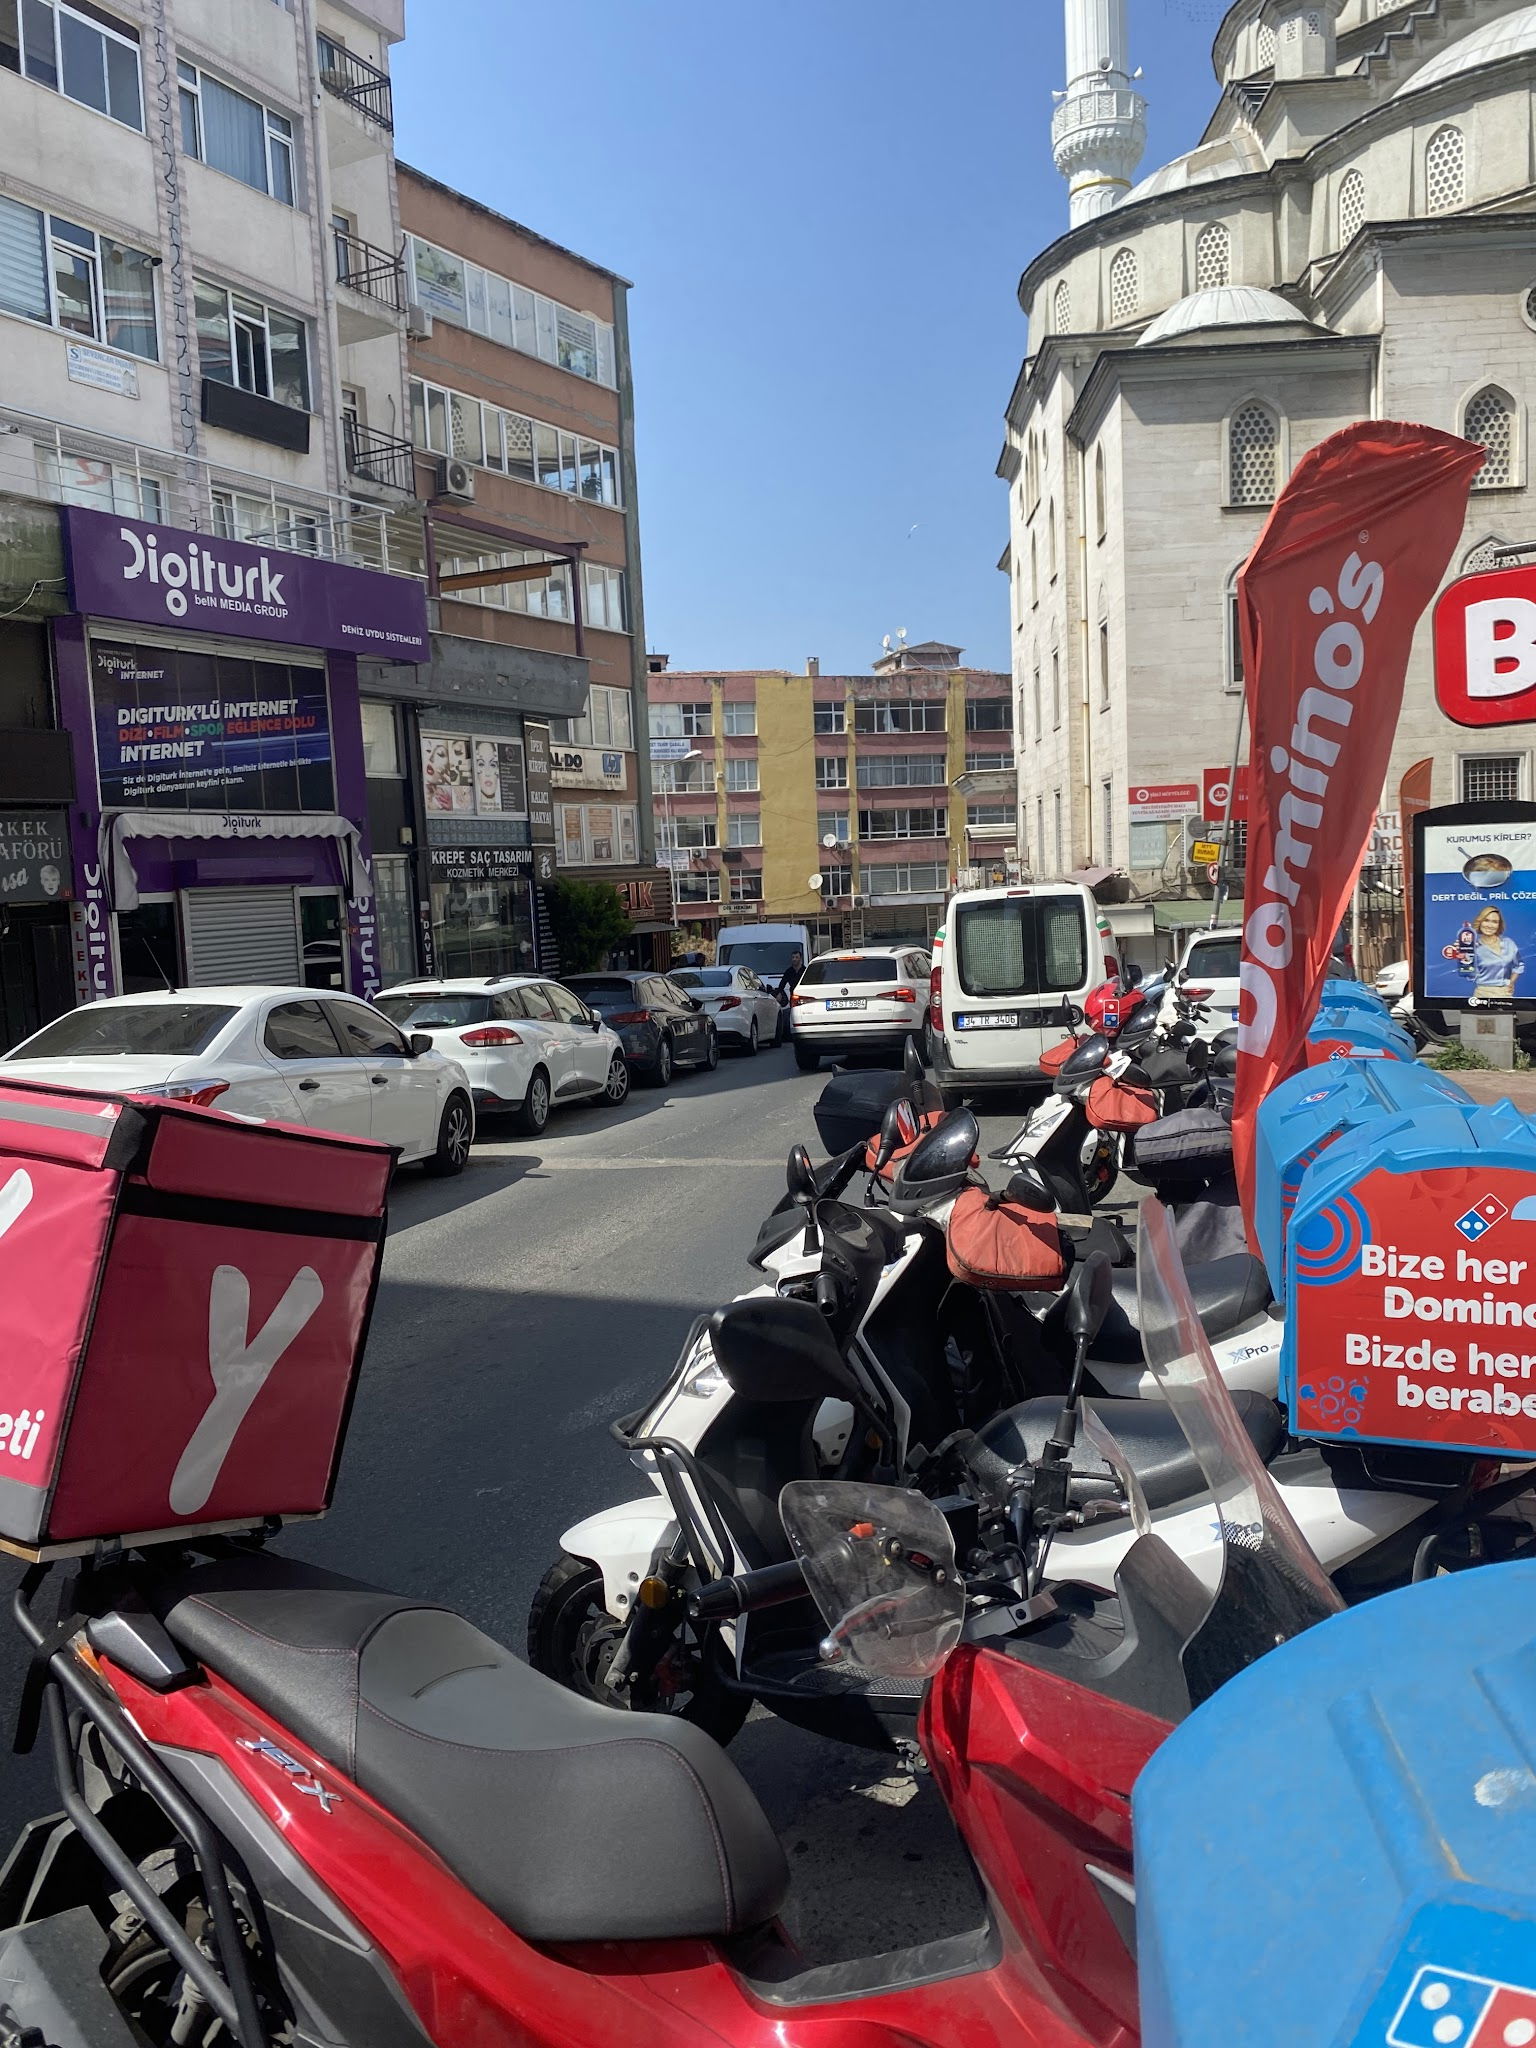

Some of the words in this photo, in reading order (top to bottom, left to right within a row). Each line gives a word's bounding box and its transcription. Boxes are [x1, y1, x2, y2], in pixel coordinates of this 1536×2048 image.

[120, 527, 287, 617] Digiturk
[220, 598, 252, 613] MEDIA
[254, 605, 289, 619] GROUP
[365, 628, 385, 640] UYDU
[1464, 597, 1536, 697] B
[285, 716, 315, 730] DOLU
[1238, 551, 1384, 1058] Domino's
[222, 815, 262, 834] Digiturk
[1447, 835, 1492, 844] KURUMUŞ
[1494, 833, 1532, 842] KİRLER?
[431, 851, 465, 864] KREPE
[470, 851, 491, 867] SAÇ
[493, 851, 532, 864] TASARIM
[447, 866, 485, 878] KOZMETİK
[488, 866, 519, 877] MERKEZİ
[1432, 893, 1456, 902] DERT
[1458, 891, 1487, 901] DEĞİL,
[1489, 891, 1510, 900] PRİL
[965, 1017, 975, 1025] 34
[980, 1015, 990, 1024] TR
[995, 1014, 1016, 1024] 3406
[1361, 1244, 1444, 1281] Bize
[1456, 1249, 1527, 1285] her
[1345, 1333, 1456, 1373] Bizde
[1468, 1342, 1536, 1379] her
